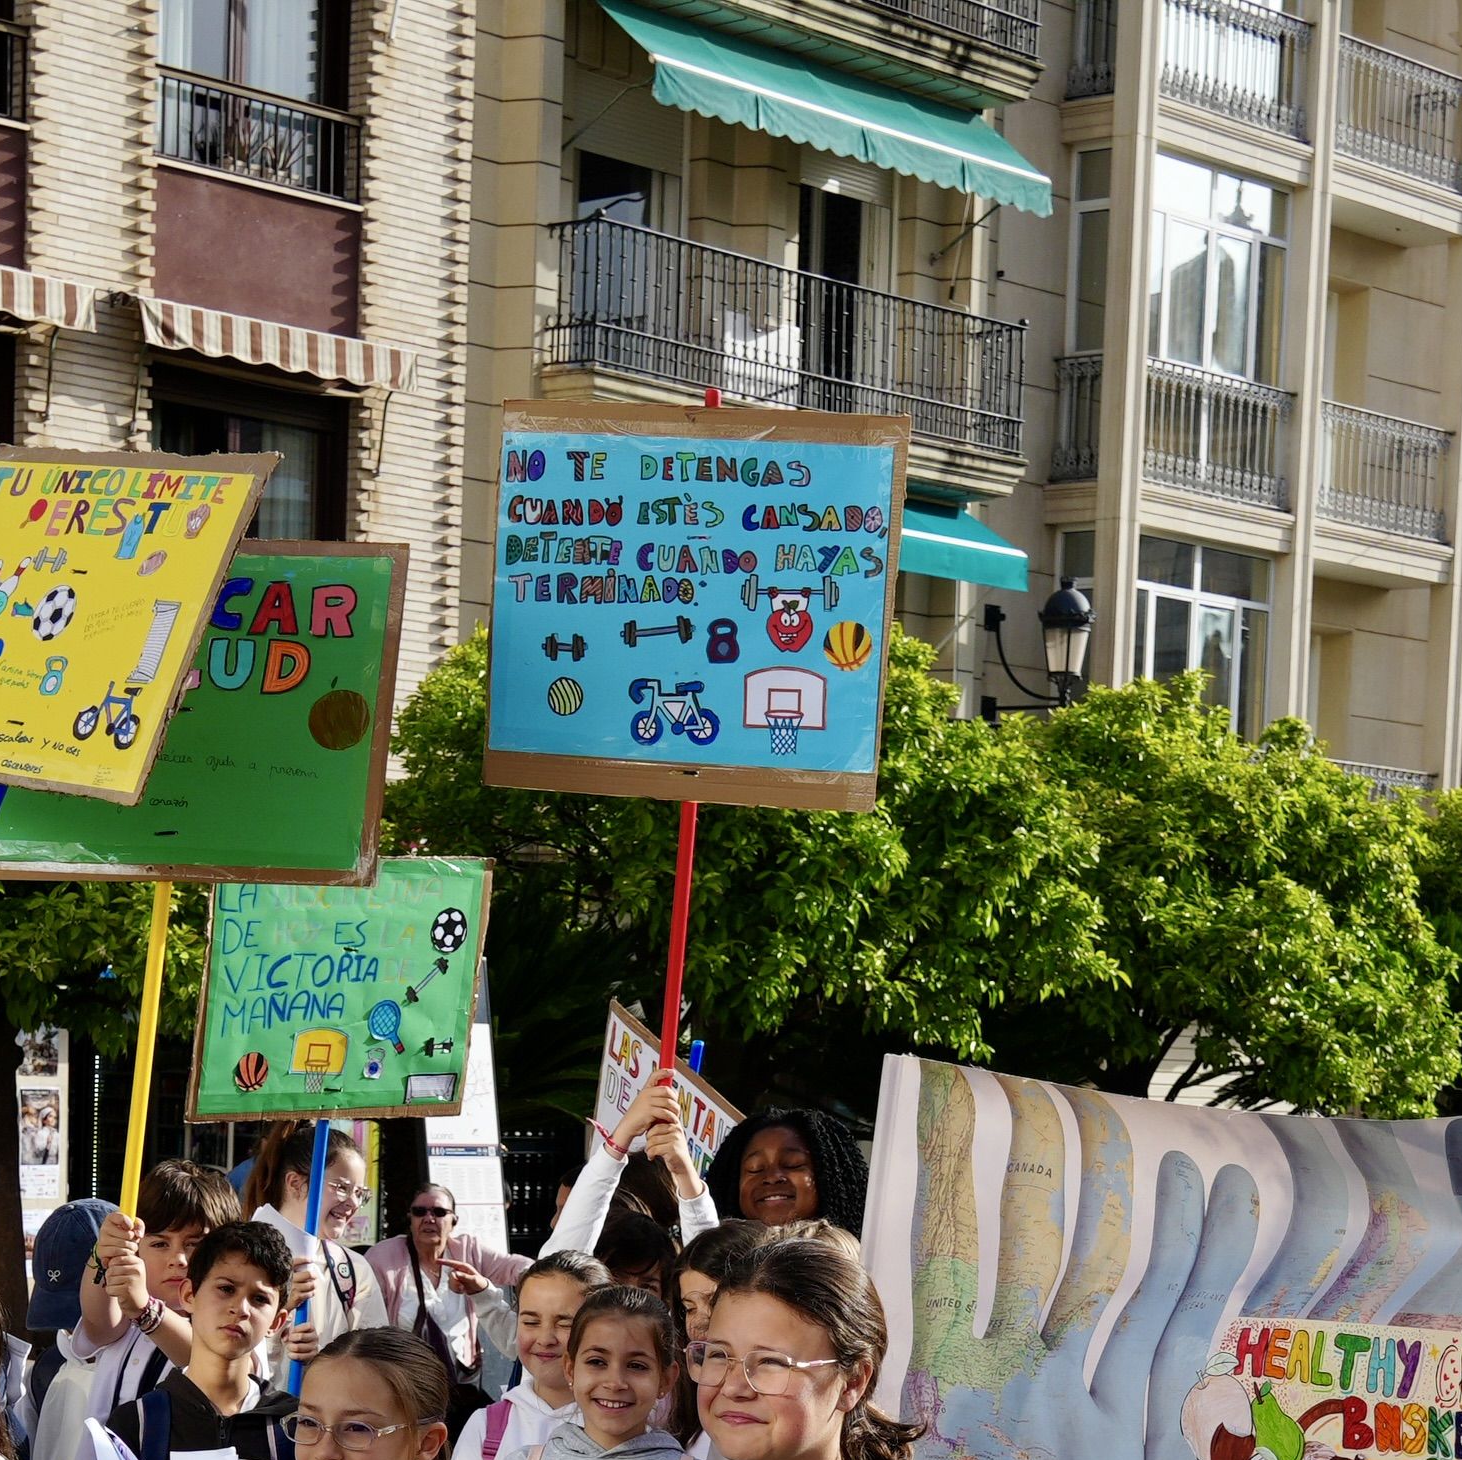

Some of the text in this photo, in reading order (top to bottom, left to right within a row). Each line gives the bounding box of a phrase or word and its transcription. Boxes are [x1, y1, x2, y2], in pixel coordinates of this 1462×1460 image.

[41, 466, 126, 496] ÚNICO
[128, 470, 233, 504] LÍMITE
[506, 450, 811, 487] NO TE DETENGAS
[45, 498, 136, 536] ERES
[507, 495, 623, 527] CUANDO
[741, 503, 888, 538] CANSADO,
[505, 531, 883, 579] DETENTE CUANDO HAYAS
[210, 577, 357, 638] CAR
[223, 918, 261, 954] DE
[335, 920, 369, 947] ES
[381, 924, 417, 948] LA
[224, 952, 379, 995] VICTORIA
[222, 990, 345, 1038] MAÑANA
[608, 1021, 642, 1078] LAS
[1006, 1162, 1053, 1179] CANADA
[926, 1298, 961, 1309] UNITED
[1233, 1327, 1422, 1400] HEALTHY
